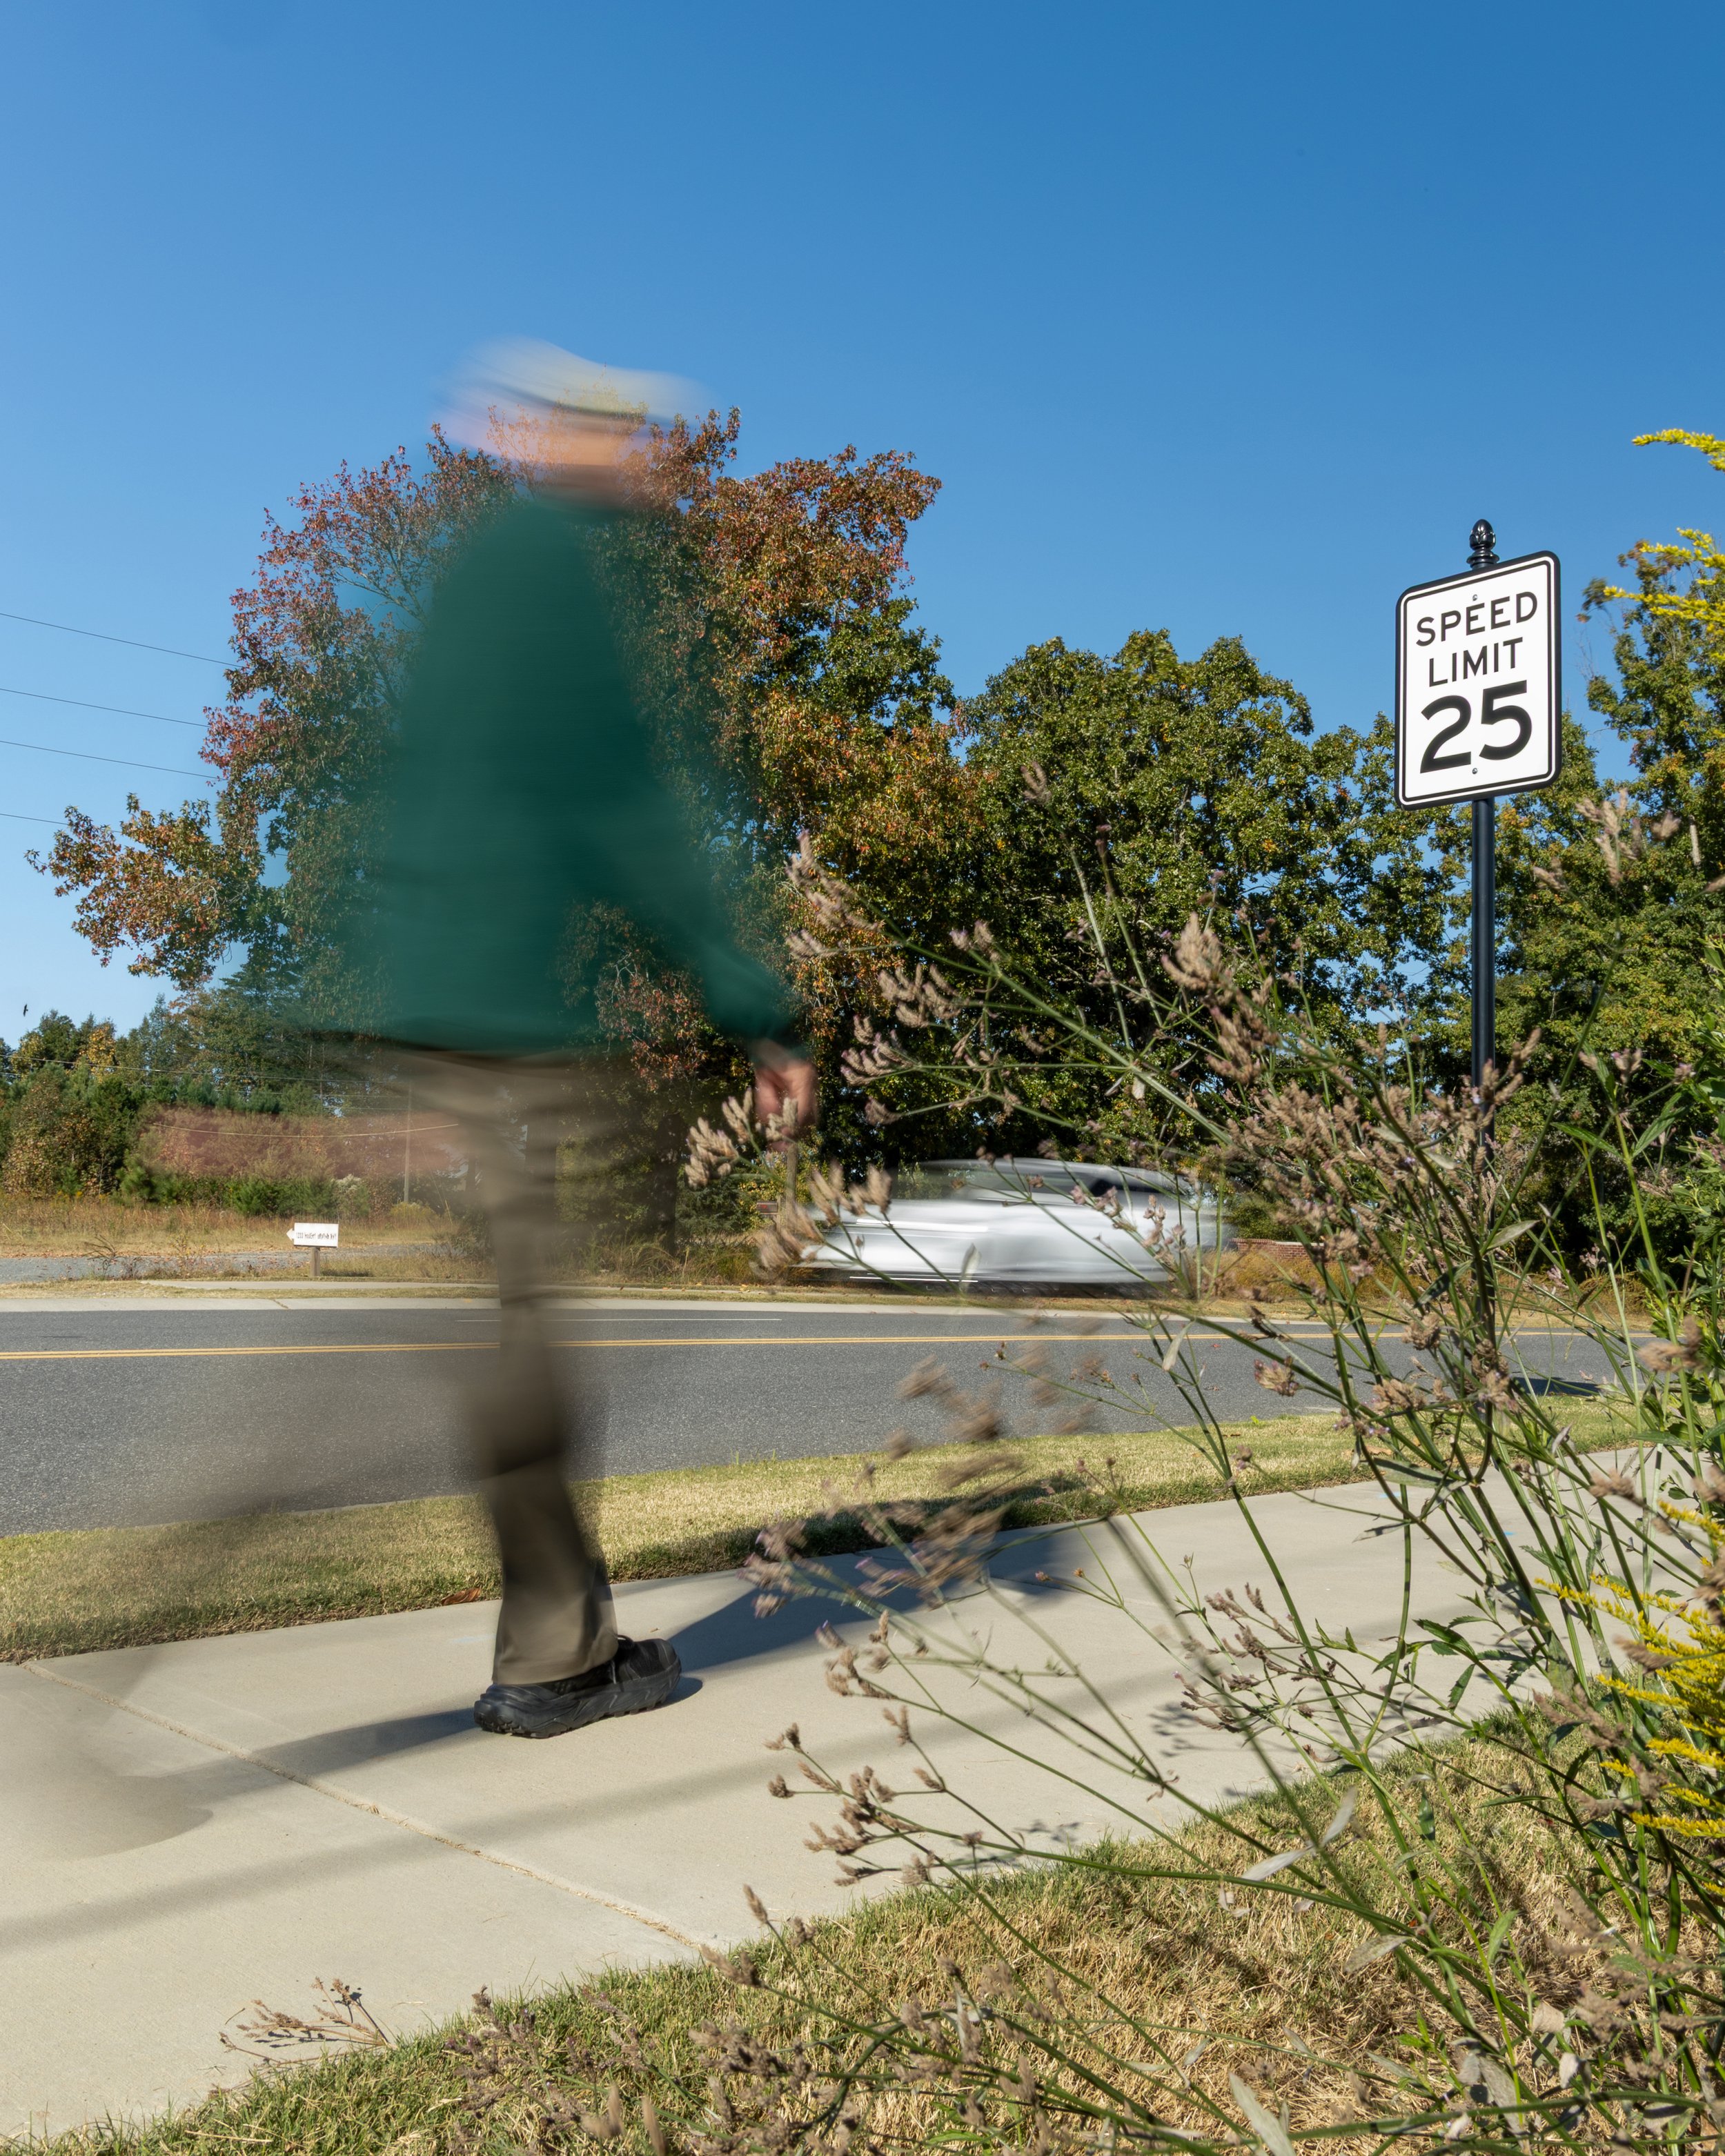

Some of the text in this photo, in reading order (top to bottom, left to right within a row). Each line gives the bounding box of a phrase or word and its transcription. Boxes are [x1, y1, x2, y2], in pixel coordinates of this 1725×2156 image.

[1416, 591, 1537, 646] SPEED
[1429, 637, 1523, 687] LIMIT
[1419, 680, 1532, 774] 25
